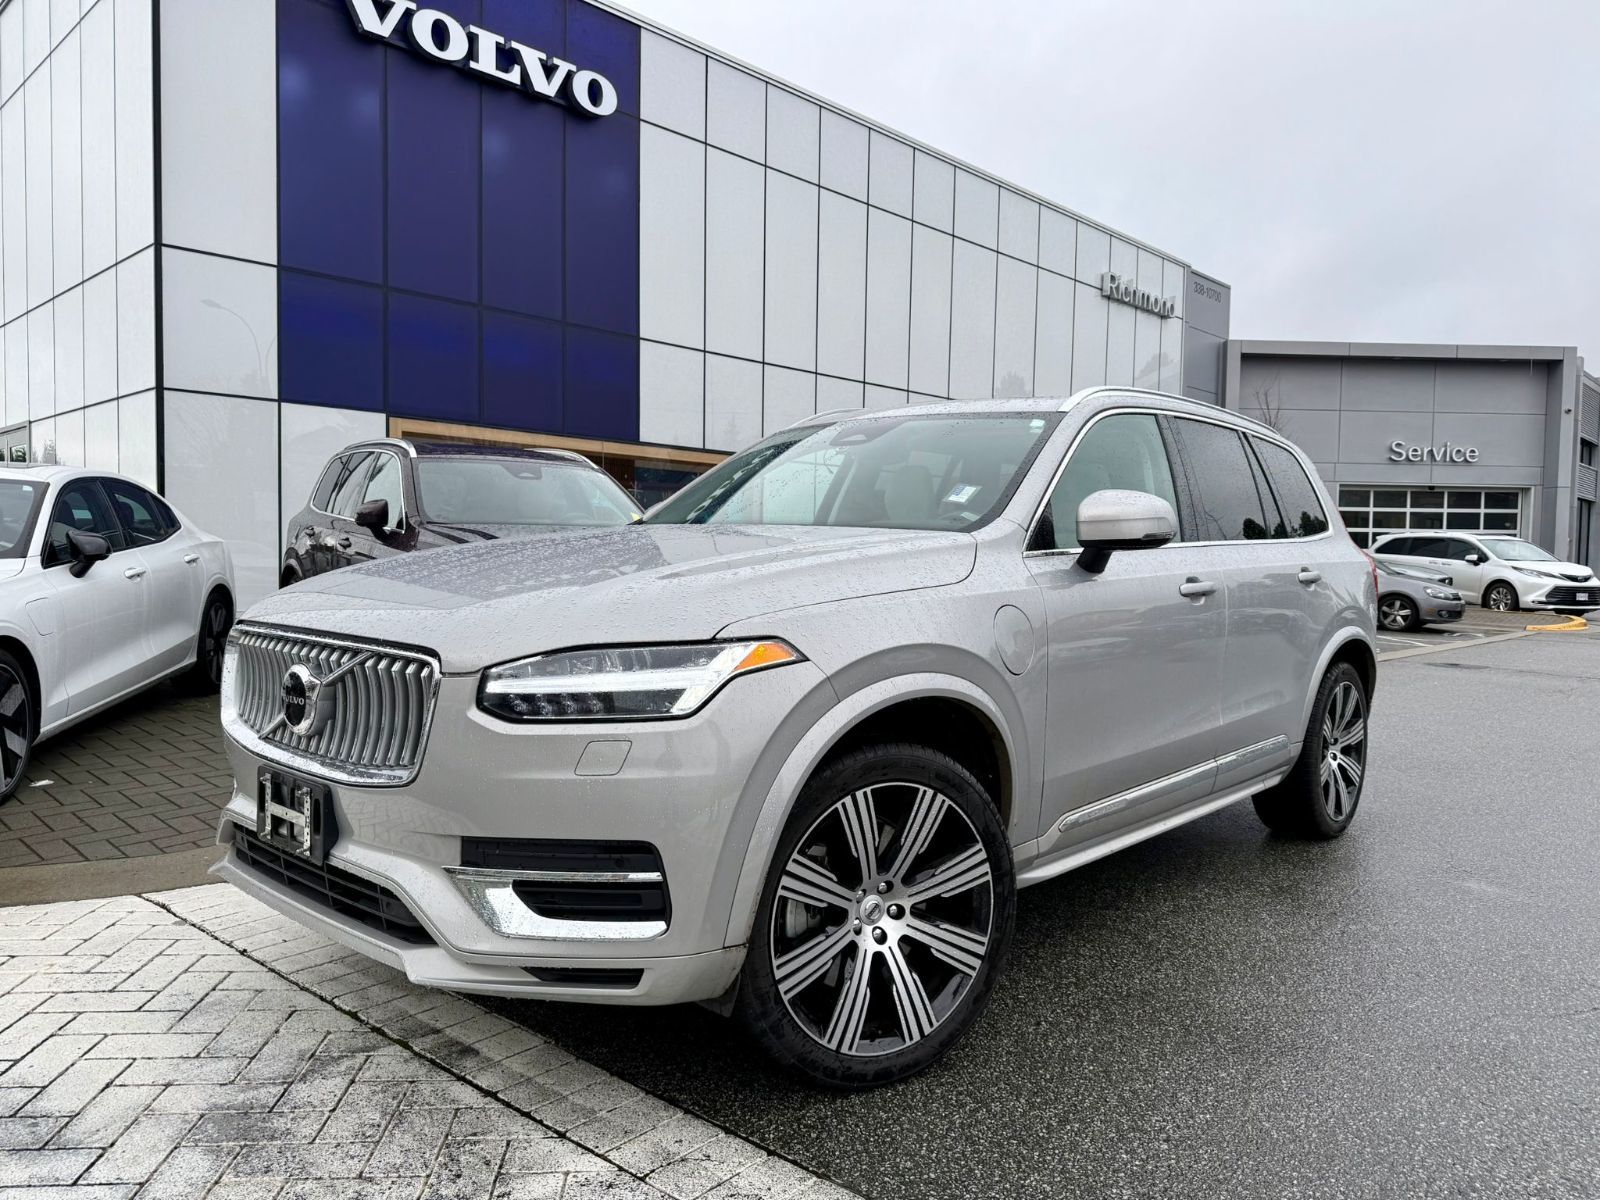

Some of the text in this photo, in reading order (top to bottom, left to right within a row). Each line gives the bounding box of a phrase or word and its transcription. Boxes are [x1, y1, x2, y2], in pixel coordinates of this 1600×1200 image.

[350, 0, 618, 117] VOLVO
[1103, 271, 1176, 318] Richmond
[1390, 440, 1479, 462] Service
